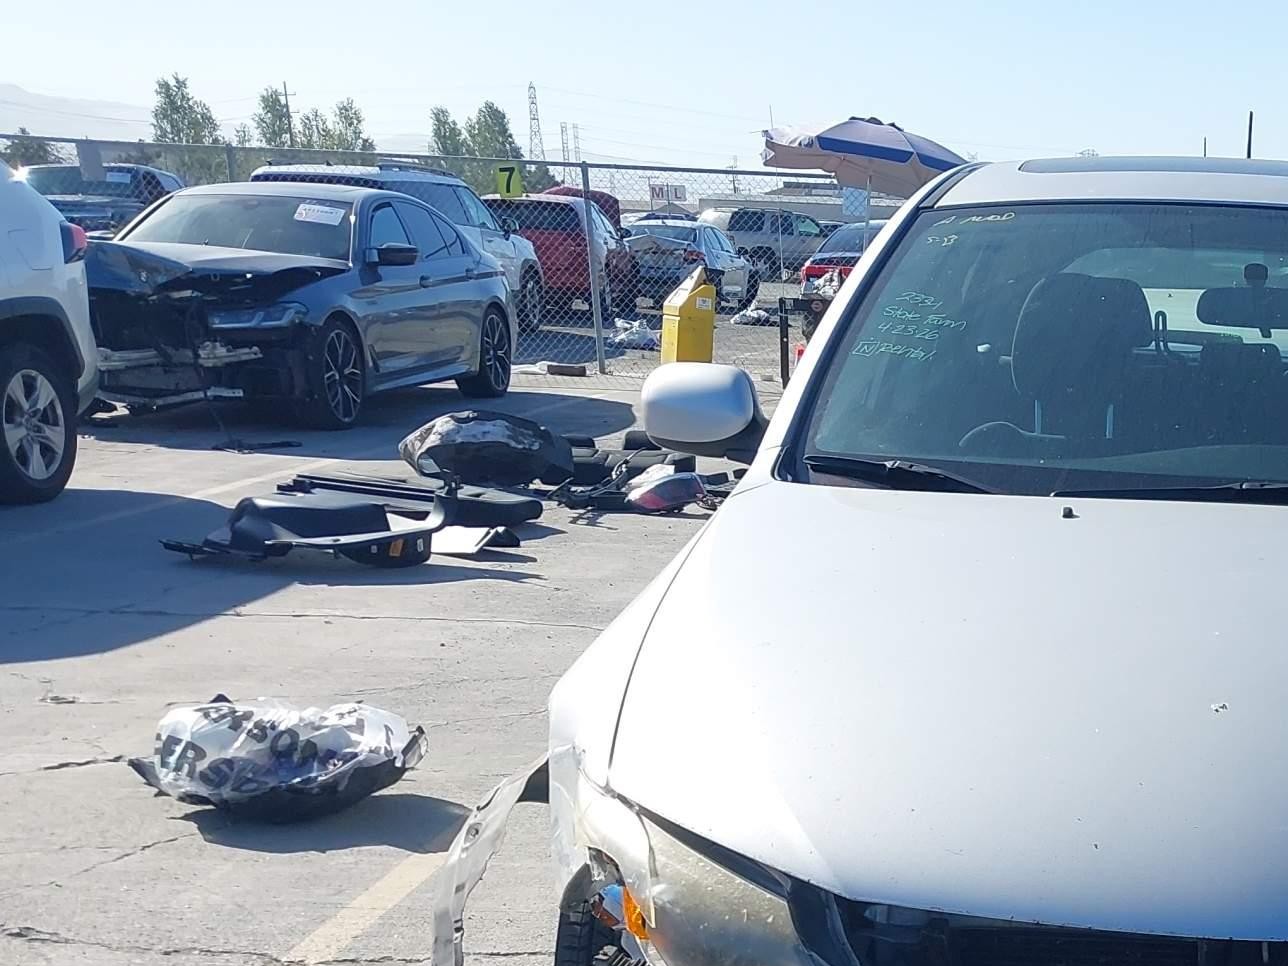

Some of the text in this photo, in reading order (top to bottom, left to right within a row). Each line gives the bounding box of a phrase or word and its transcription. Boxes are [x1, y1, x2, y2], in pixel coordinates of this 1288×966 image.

[498, 166, 515, 194] 7
[651, 186, 665, 199] M
[674, 187, 683, 199] L
